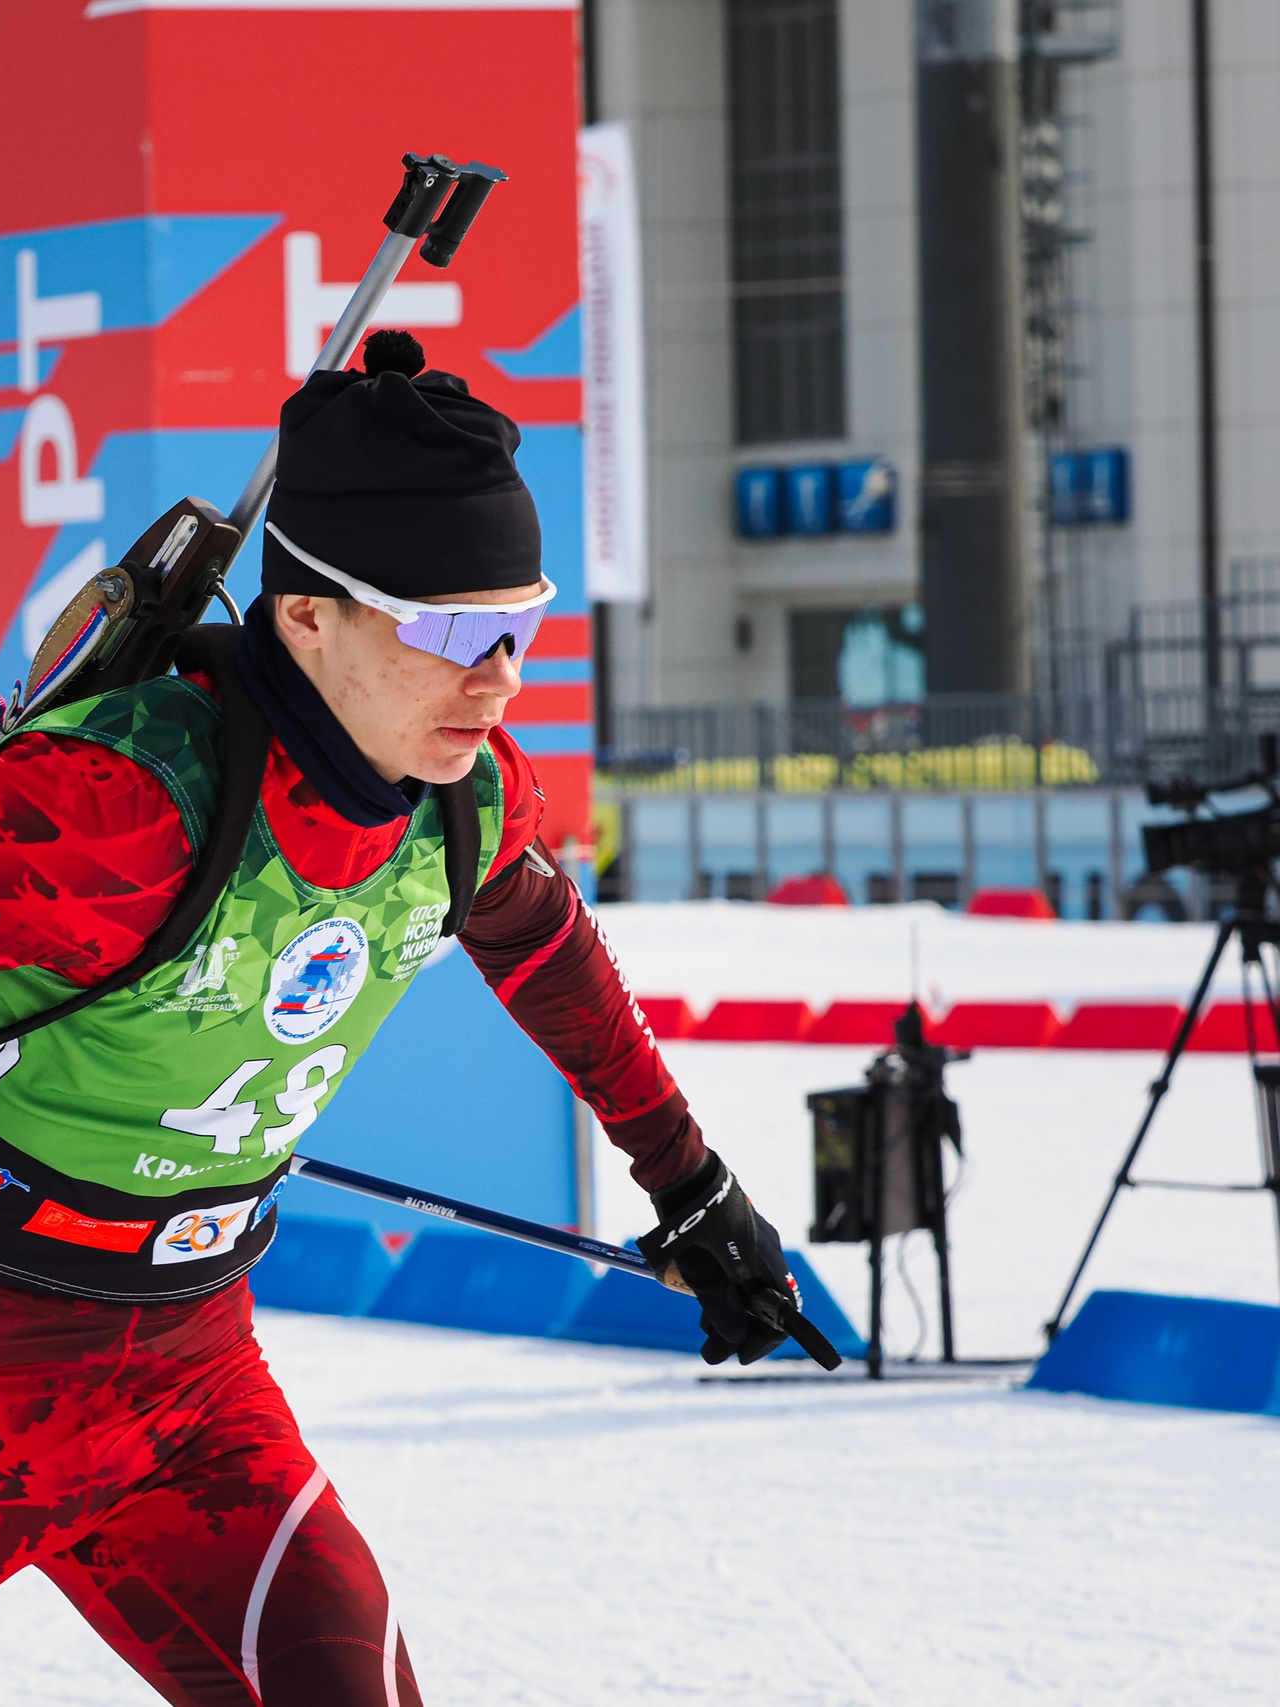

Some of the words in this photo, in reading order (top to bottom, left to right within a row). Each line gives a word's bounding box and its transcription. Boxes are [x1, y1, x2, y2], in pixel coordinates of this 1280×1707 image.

[409, 900, 451, 923] СПОР
[281, 920, 341, 962] ПЕРВЕНСТВО
[342, 920, 365, 950] РОССИИ
[159, 1043, 348, 1157] 49
[404, 1196, 458, 1219] NANOLITE
[726, 1241, 741, 1261] LEFT
